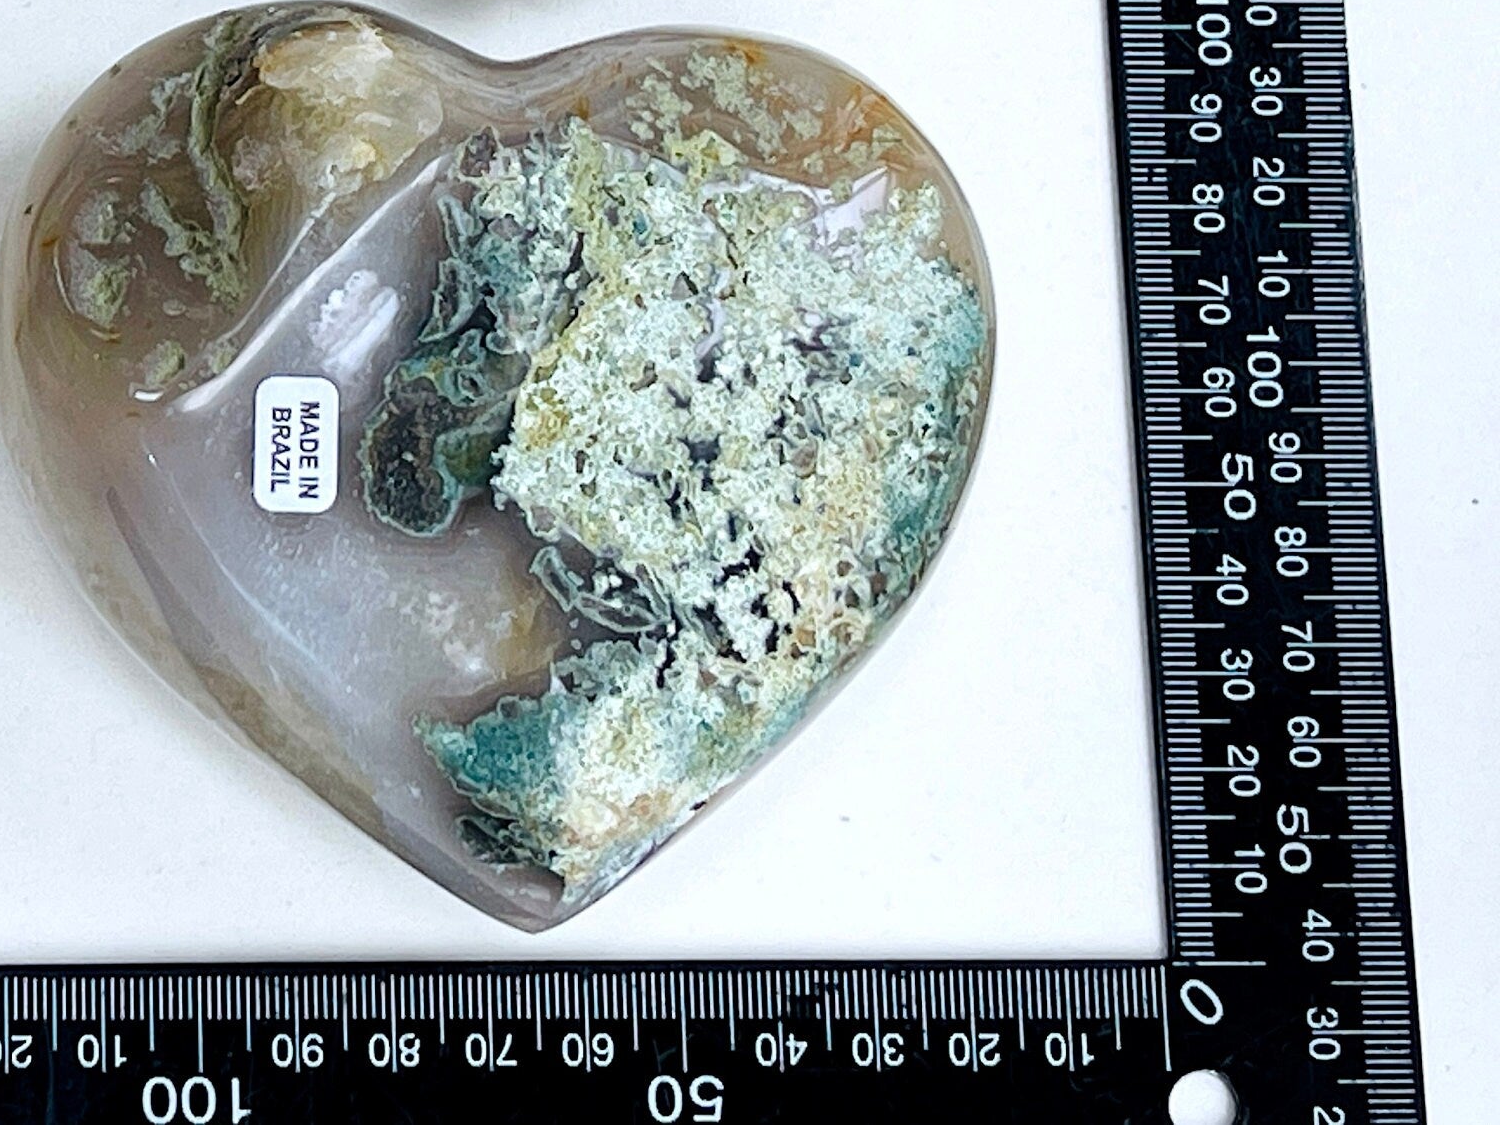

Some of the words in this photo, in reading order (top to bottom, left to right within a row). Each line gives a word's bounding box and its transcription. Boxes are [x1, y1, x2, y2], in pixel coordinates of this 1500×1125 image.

[1249, 66, 1284, 116] 30
[1190, 94, 1222, 143] 90
[1252, 157, 1285, 206] 20
[1192, 184, 1225, 233] 80
[1257, 250, 1291, 298] 10
[1198, 275, 1231, 325] 70
[1202, 366, 1237, 418] 60
[1246, 326, 1284, 408] 100
[271, 406, 292, 493] BRAZIL
[299, 401, 320, 469] MADE
[1268, 432, 1302, 483] 90
[299, 477, 319, 498] IN
[1221, 452, 1257, 520] 50
[1274, 526, 1309, 577] 80
[1216, 554, 1249, 605] 40
[1281, 621, 1315, 673] 70
[1220, 648, 1255, 701] 30
[1287, 716, 1321, 768] 60
[1227, 745, 1261, 797] 20
[1276, 804, 1312, 874] 50
[1234, 844, 1268, 894] 10
[1302, 909, 1335, 962] 40
[1180, 979, 1224, 1025] 0
[78, 1033, 127, 1067] 10
[271, 1032, 324, 1067] 90
[368, 1032, 420, 1067] 80
[465, 1032, 518, 1067] 70
[562, 1032, 614, 1067] 60
[755, 1032, 808, 1067] 40
[853, 1032, 905, 1067] 30
[949, 1032, 1001, 1066] 20
[1045, 1032, 1095, 1066] 10
[1306, 1006, 1341, 1061] 30
[142, 1076, 252, 1125] 100
[647, 1075, 725, 1123] 50
